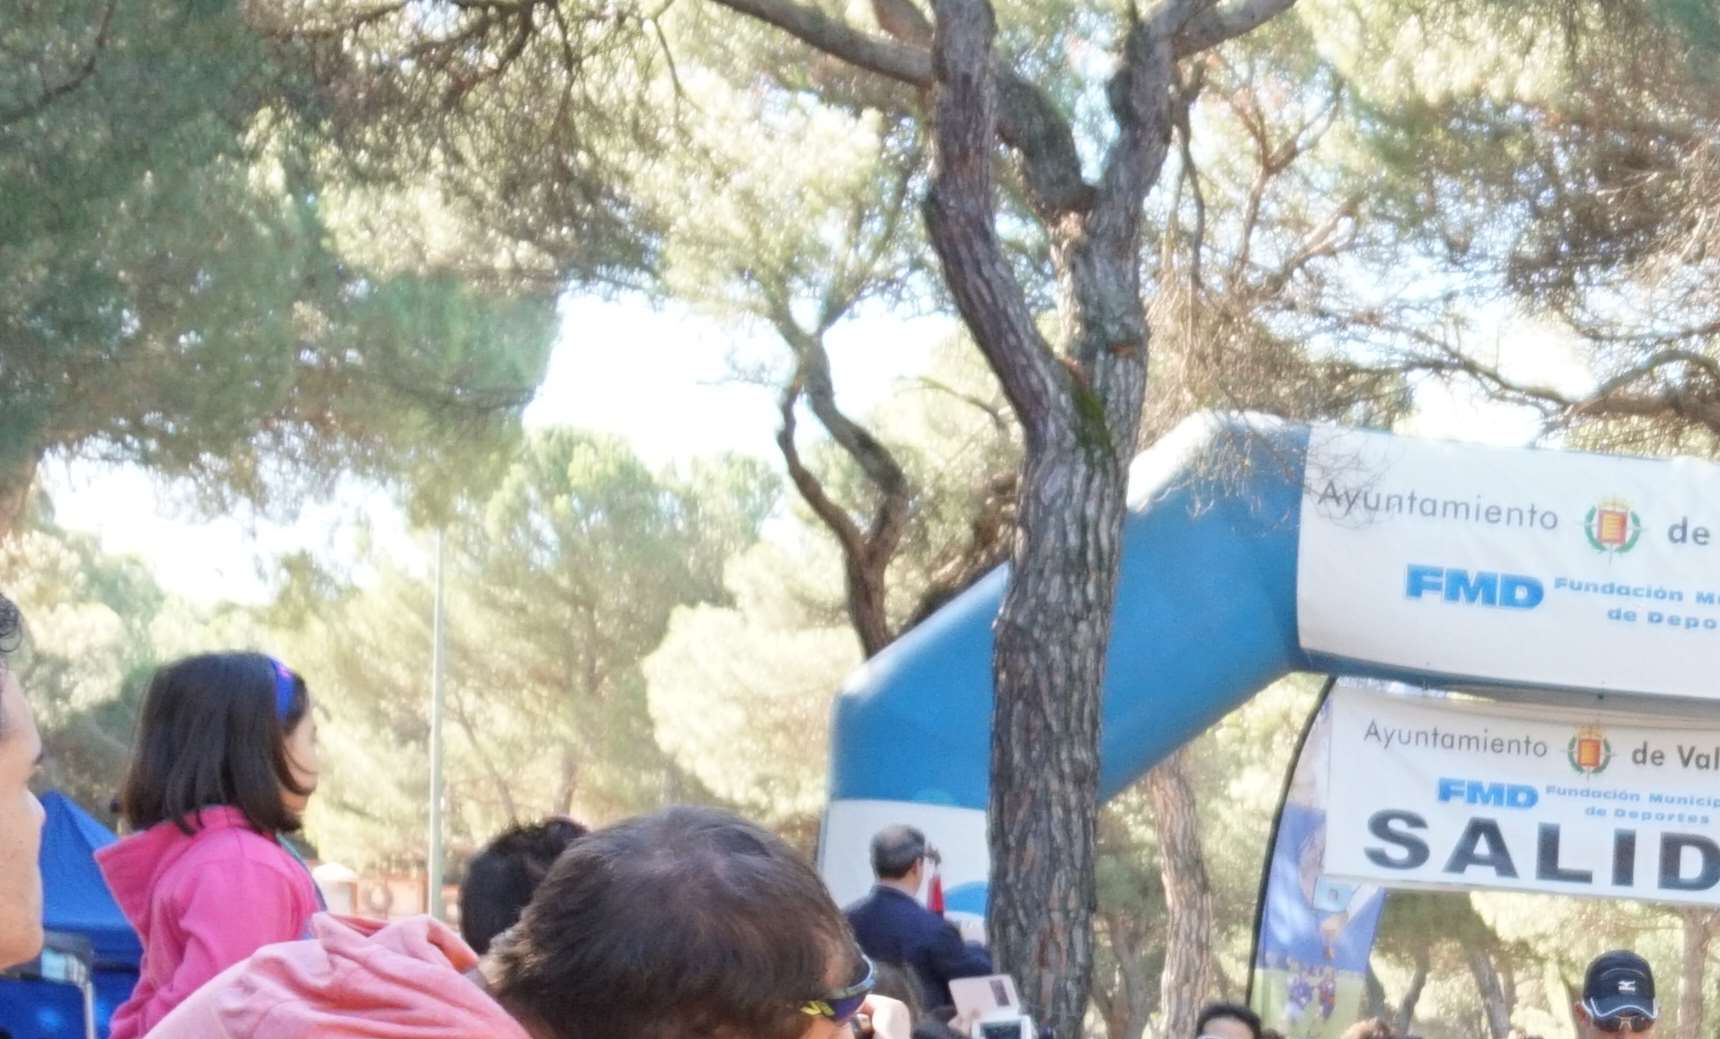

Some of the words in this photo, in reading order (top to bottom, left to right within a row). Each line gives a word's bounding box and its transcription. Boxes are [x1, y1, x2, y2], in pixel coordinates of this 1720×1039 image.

[1318, 481, 1560, 532] Ayuntamiento
[1667, 515, 1711, 546] de
[1405, 563, 1546, 610] FMD
[1554, 576, 1684, 602] Fundación
[1606, 605, 1638, 623] de
[1364, 719, 1549, 761] Ayuntamiento
[1631, 741, 1666, 767] de
[1436, 776, 1539, 810] FMD
[1545, 784, 1641, 803] Fundación
[1585, 805, 1609, 817] de
[1614, 807, 1711, 824] Deportes
